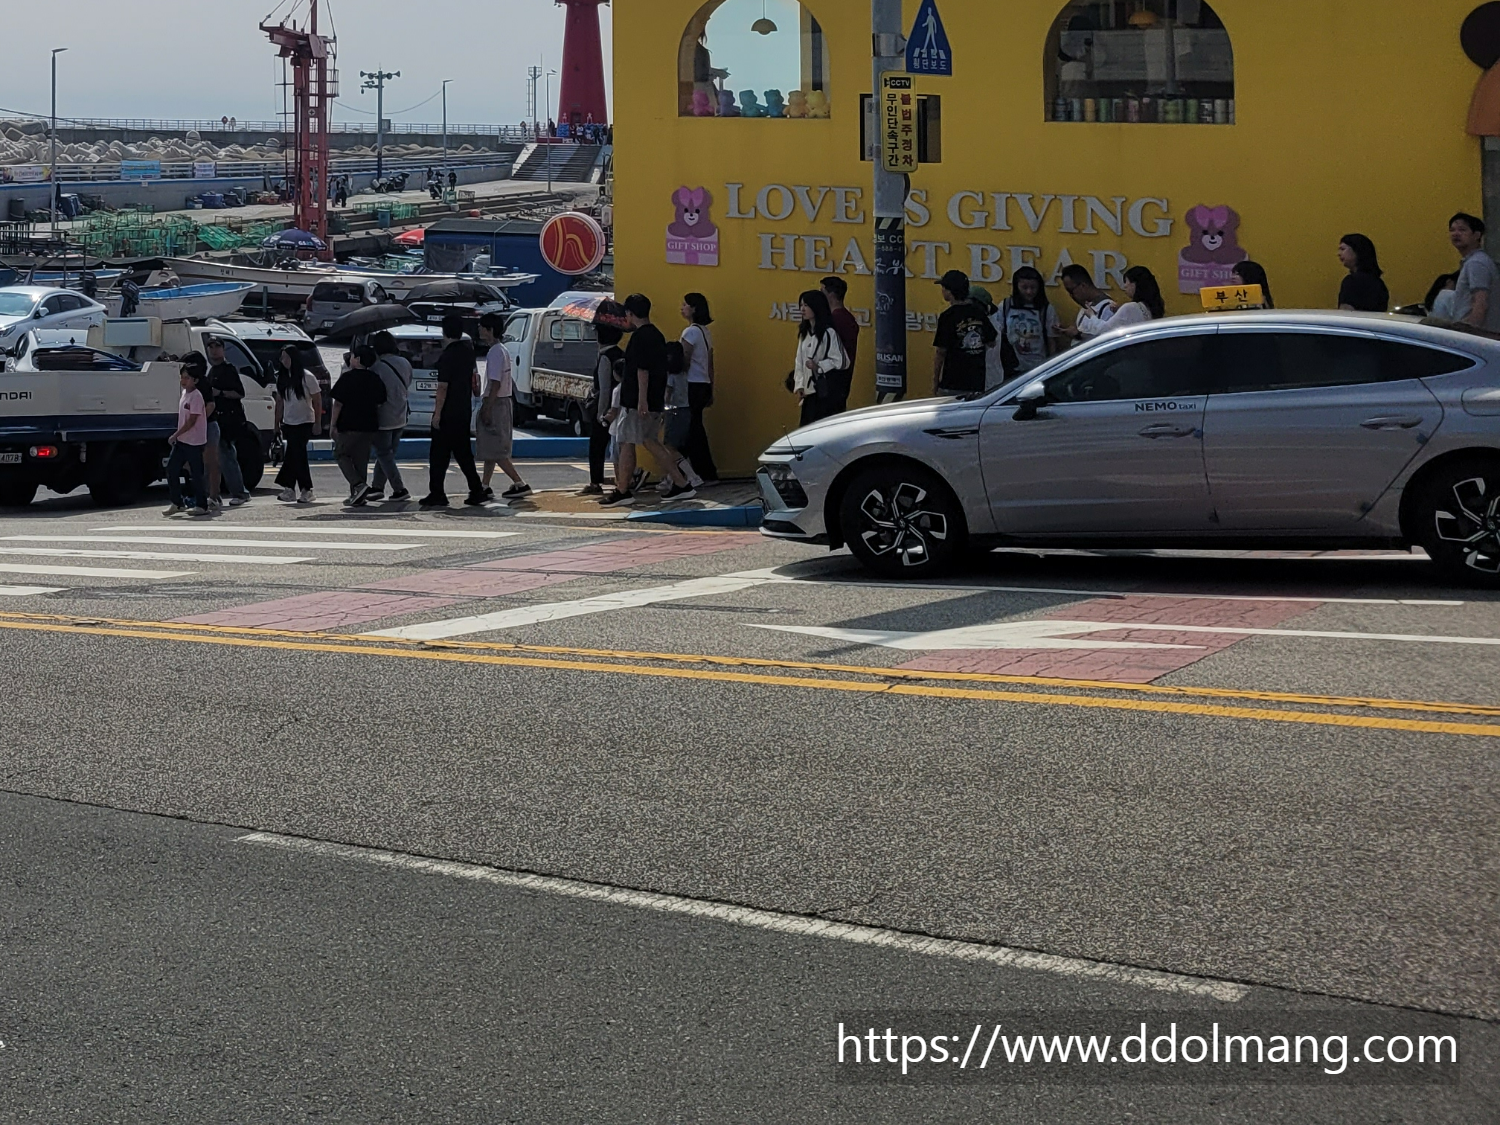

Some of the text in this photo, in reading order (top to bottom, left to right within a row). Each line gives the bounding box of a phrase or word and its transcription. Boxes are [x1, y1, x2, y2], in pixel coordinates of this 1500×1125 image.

[913, 58, 947, 71] 횡단보도
[890, 78, 910, 88] CCTV
[886, 93, 900, 167] 무인단속구간
[900, 93, 914, 167] 불법주정차
[725, 182, 864, 224] LOVE
[947, 189, 1174, 238] GIVING
[667, 241, 716, 252] GIFT SHOP
[758, 232, 1128, 291] HEAT BEAR
[1181, 268, 1208, 278] GIFT
[1214, 288, 1248, 303] 부산
[876, 352, 904, 363] BUSAN
[1135, 401, 1197, 412] NEMO taxi
